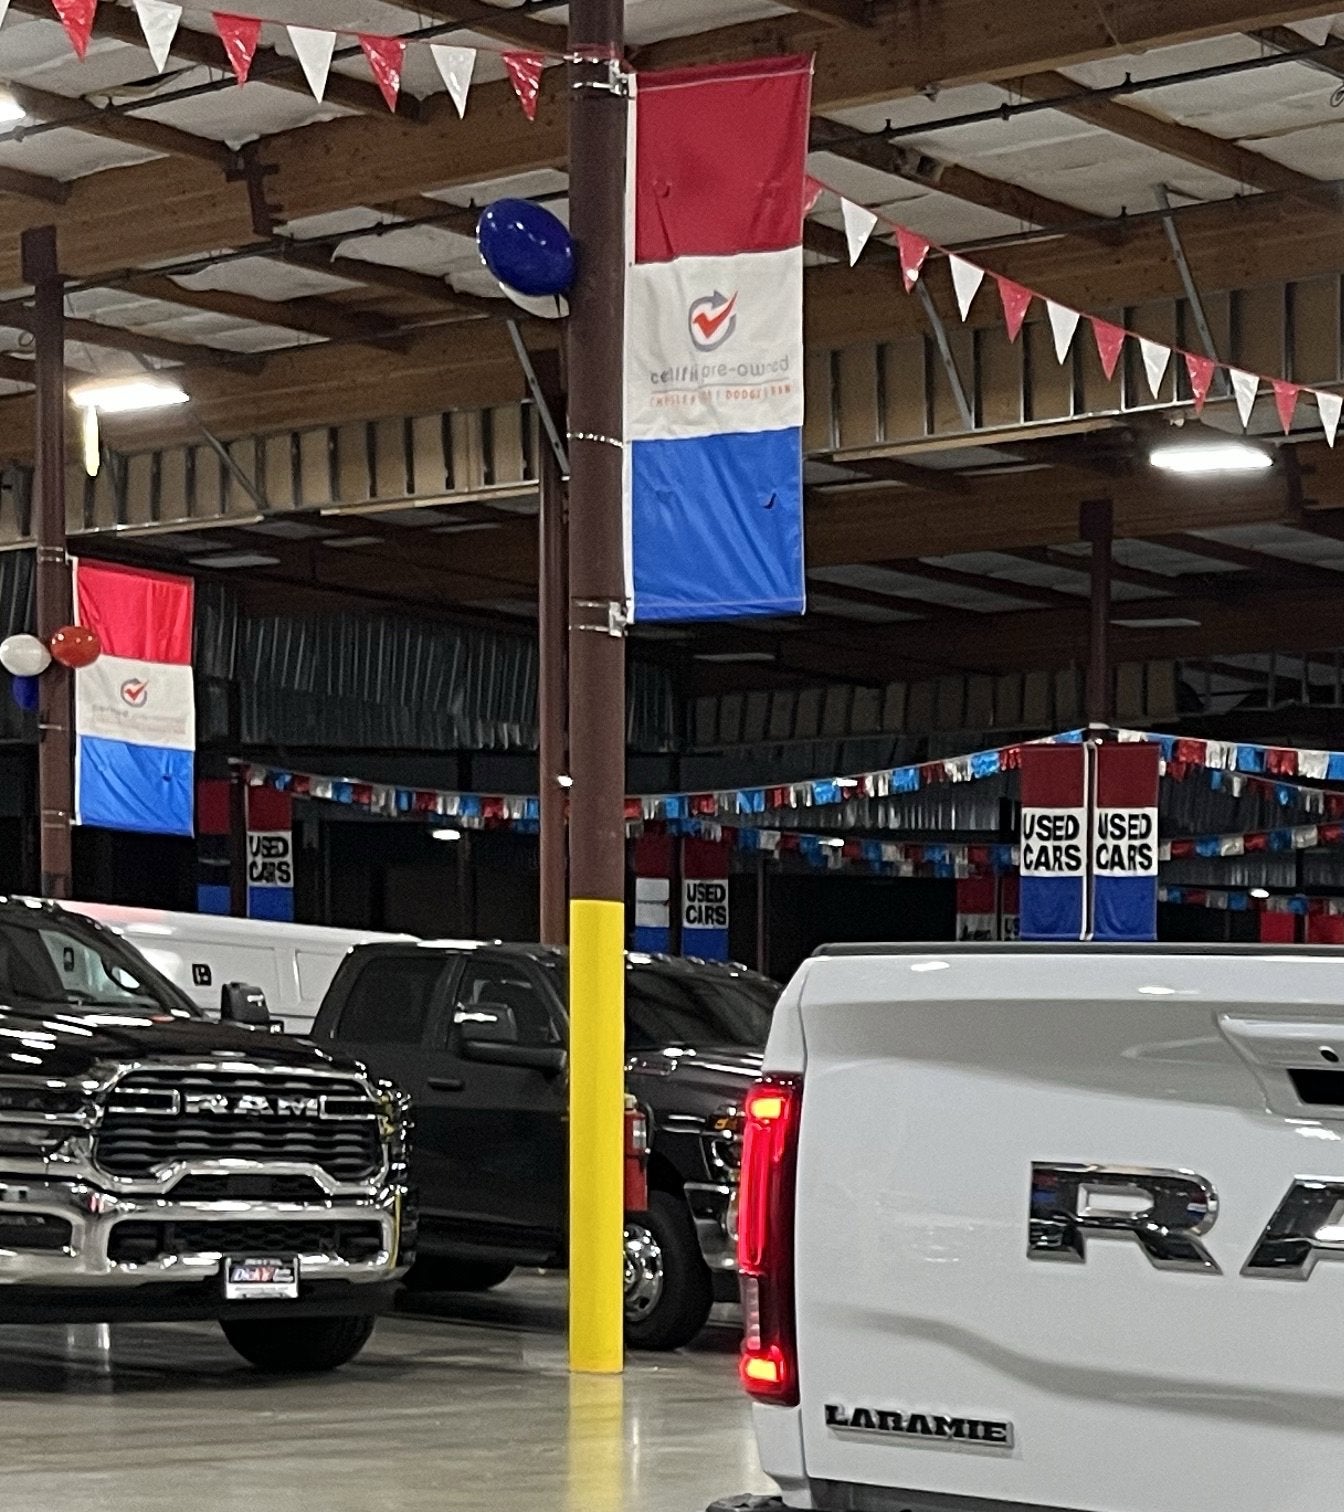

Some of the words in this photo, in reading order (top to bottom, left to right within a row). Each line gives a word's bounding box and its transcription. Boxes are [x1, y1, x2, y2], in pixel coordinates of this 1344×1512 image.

[702, 355, 789, 384] pre-owed
[1023, 813, 1080, 841] USED
[1098, 813, 1152, 840] USED
[1023, 843, 1082, 871] CARS
[1096, 843, 1153, 870] CARS
[249, 860, 291, 883] CS
[686, 883, 727, 904] USED
[185, 1093, 318, 1116] RAM
[824, 1404, 1014, 1449] LARAMIE
